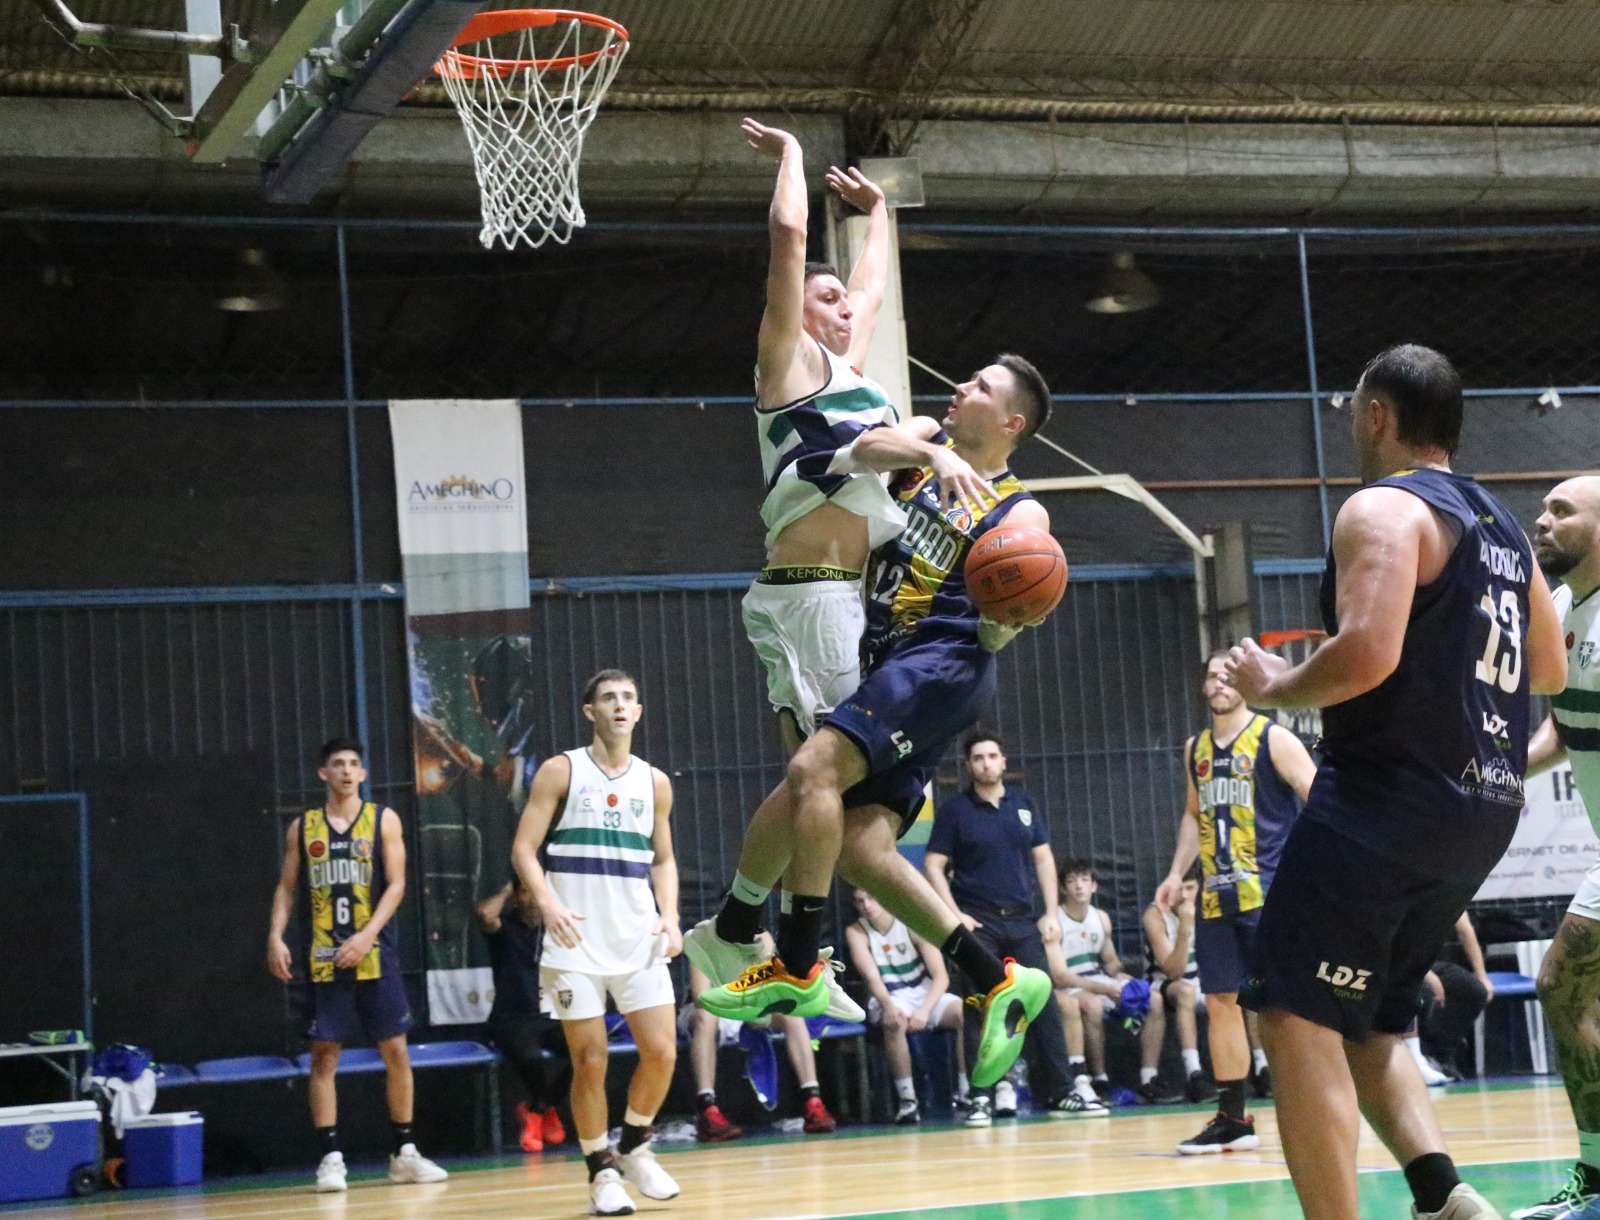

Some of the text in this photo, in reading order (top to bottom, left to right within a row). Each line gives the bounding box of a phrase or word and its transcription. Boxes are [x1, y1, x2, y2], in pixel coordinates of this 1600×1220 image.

[408, 478, 514, 501] AMEGHINO
[787, 568, 844, 580] KEMONA
[870, 560, 904, 605] 12
[1475, 584, 1521, 694] 13
[603, 810, 621, 828] 33
[1559, 844, 1578, 855] DE
[336, 896, 350, 925] 6
[1316, 961, 1373, 991] LDZ
